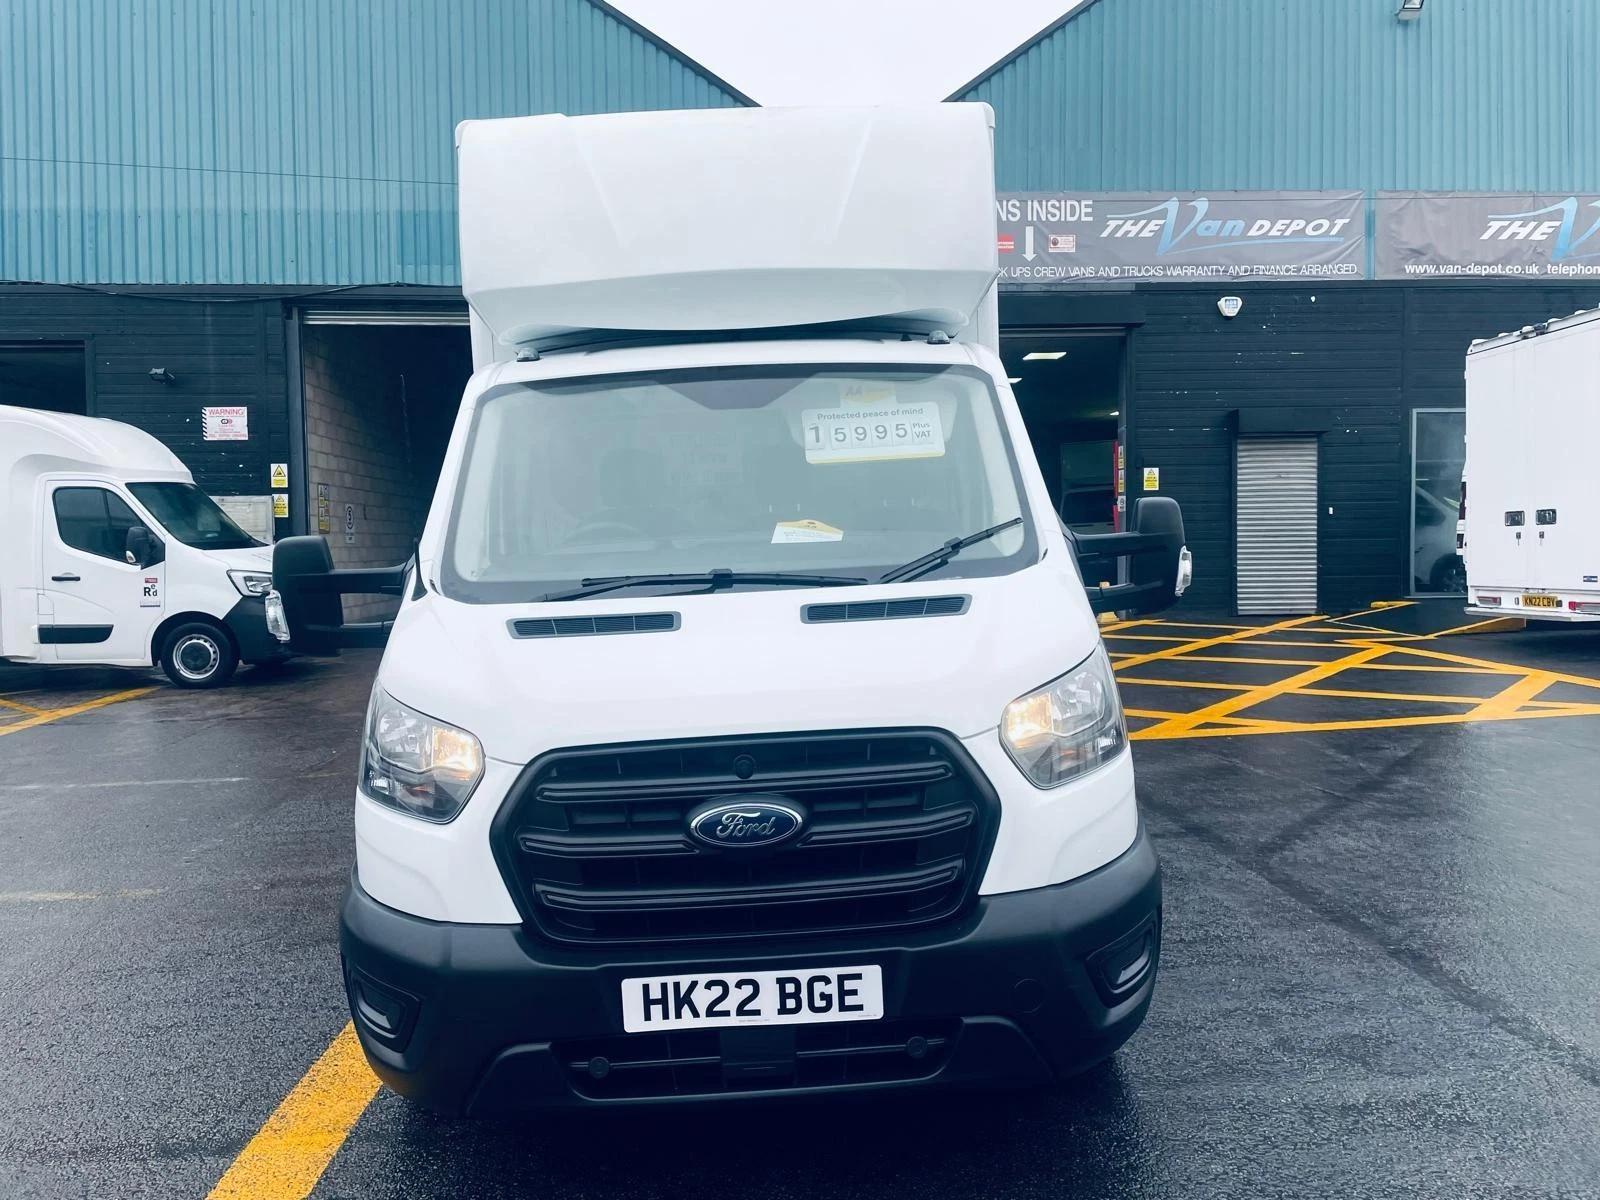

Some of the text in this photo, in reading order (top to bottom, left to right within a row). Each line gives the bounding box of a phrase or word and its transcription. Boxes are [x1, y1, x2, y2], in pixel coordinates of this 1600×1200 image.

[1027, 199, 1094, 222] INSIDE
[1100, 196, 1352, 256] THE Van DEPOT
[1480, 220, 1563, 241] THE
[1010, 266, 1032, 278] UPS
[1033, 266, 1066, 278] CREW
[1067, 265, 1099, 278] VANS
[1099, 265, 1121, 277] AND
[1122, 265, 1163, 277] TRUCKS
[1166, 264, 1226, 277] WARRANTY
[1227, 264, 1251, 277] AND
[1253, 264, 1298, 276] FINANCE
[1299, 263, 1358, 275] ARRANGED
[1404, 262, 1540, 277] www.van-depot.co.uk
[817, 407, 924, 421] Protected peace of mind
[914, 430, 932, 439] VAT
[716, 811, 776, 838] Ford
[641, 972, 865, 1022] HK22 BGE
